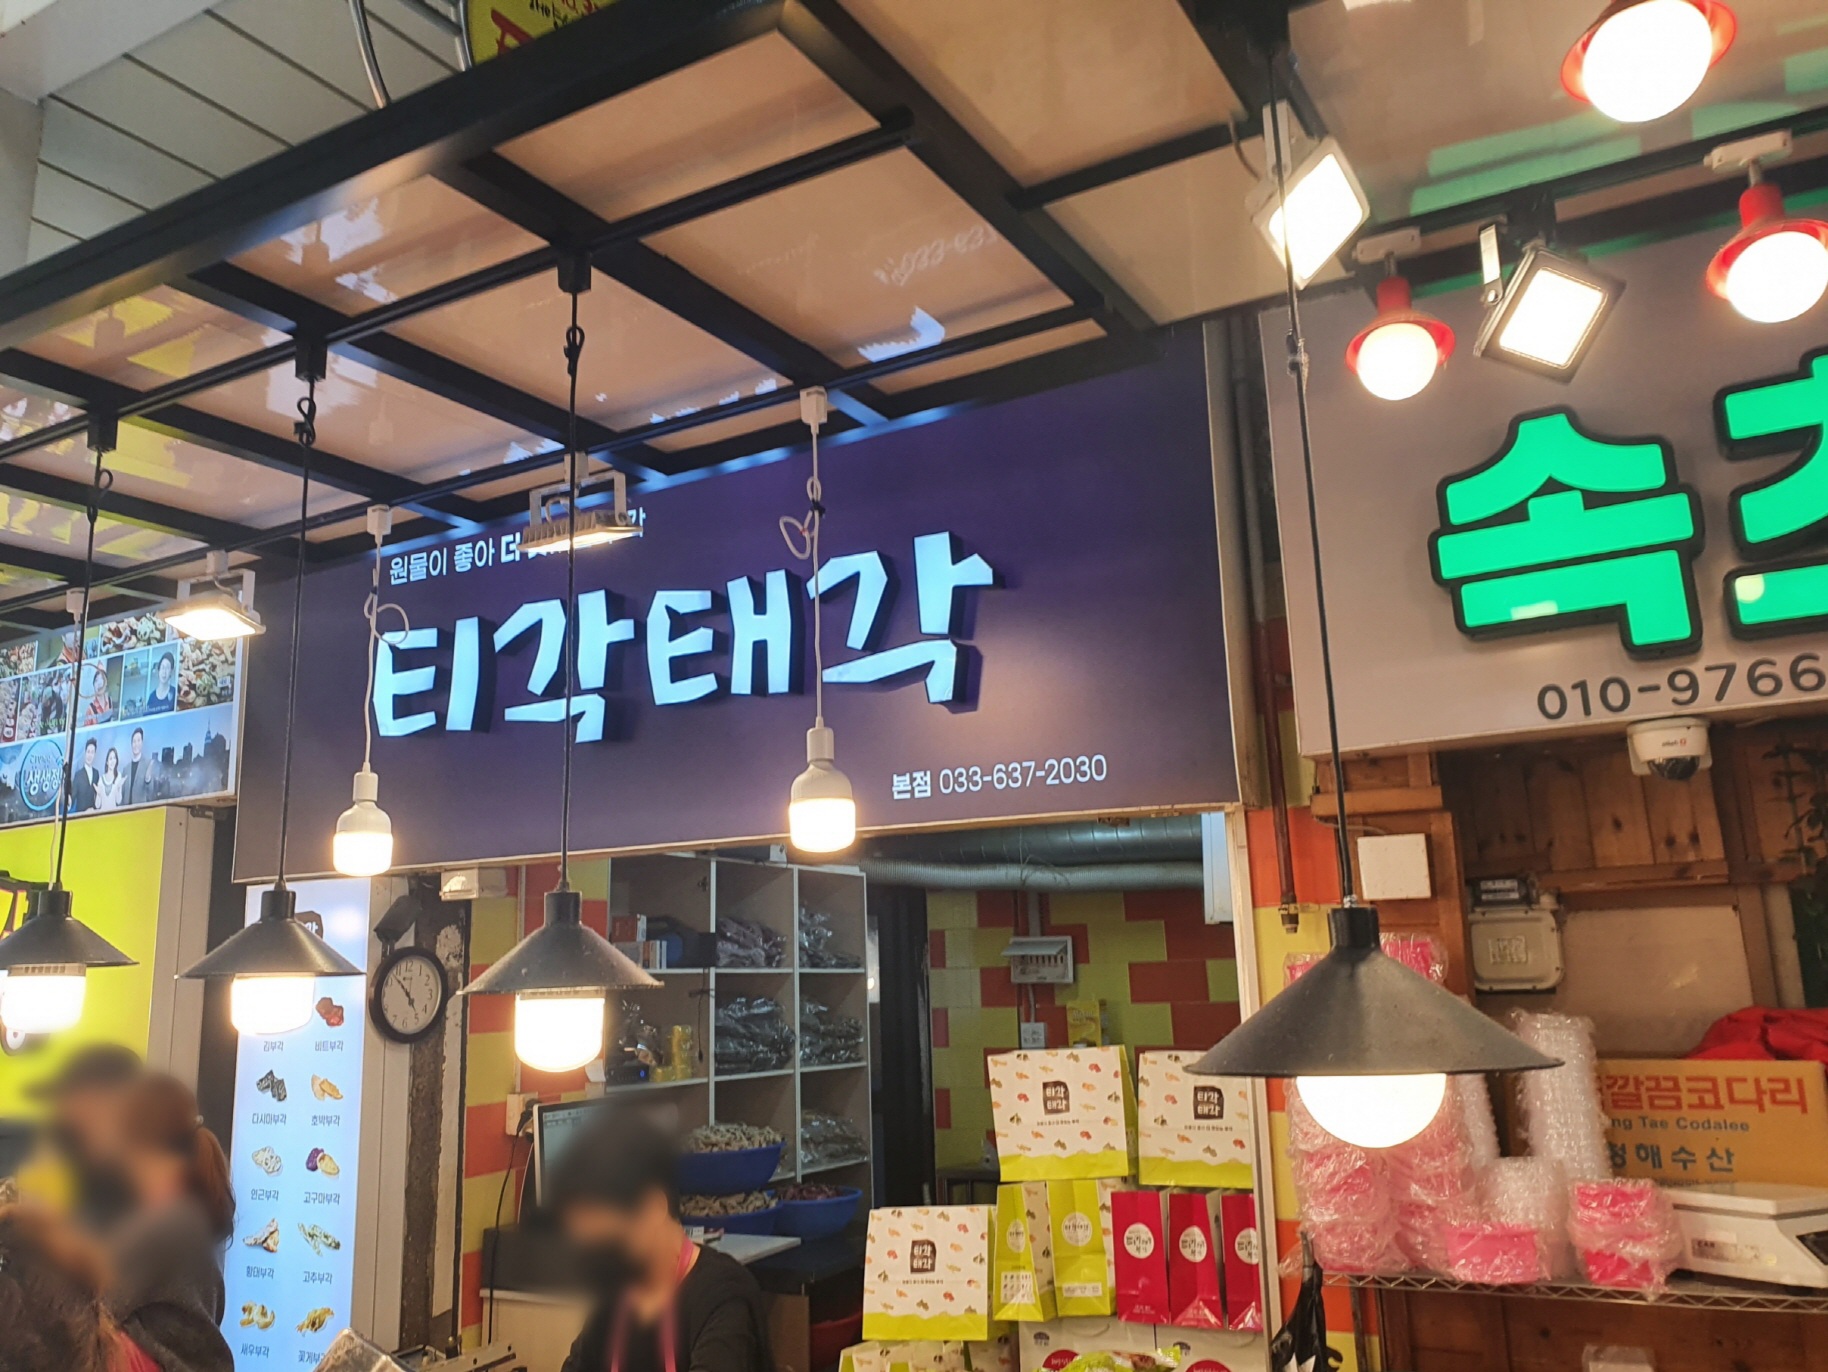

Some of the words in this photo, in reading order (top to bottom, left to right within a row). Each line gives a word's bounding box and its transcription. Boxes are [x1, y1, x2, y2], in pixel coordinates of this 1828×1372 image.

[389, 548, 448, 586] 원물이
[453, 537, 495, 574] 좋아
[500, 531, 521, 563] 더
[373, 531, 994, 743] 티각태각
[1537, 652, 1827, 720] 010-9766
[26, 768, 63, 796] 생생정
[892, 770, 931, 800] 본점
[939, 754, 1107, 794] 033-637-2030
[315, 1040, 344, 1052] 비트부각
[1597, 1075, 1808, 1114] 깔끔코다리
[252, 1113, 287, 1125] 다시마부각
[1640, 1115, 1669, 1130] Tae
[304, 1191, 340, 1205] 고구마부각
[241, 1343, 269, 1359] 새우부각
